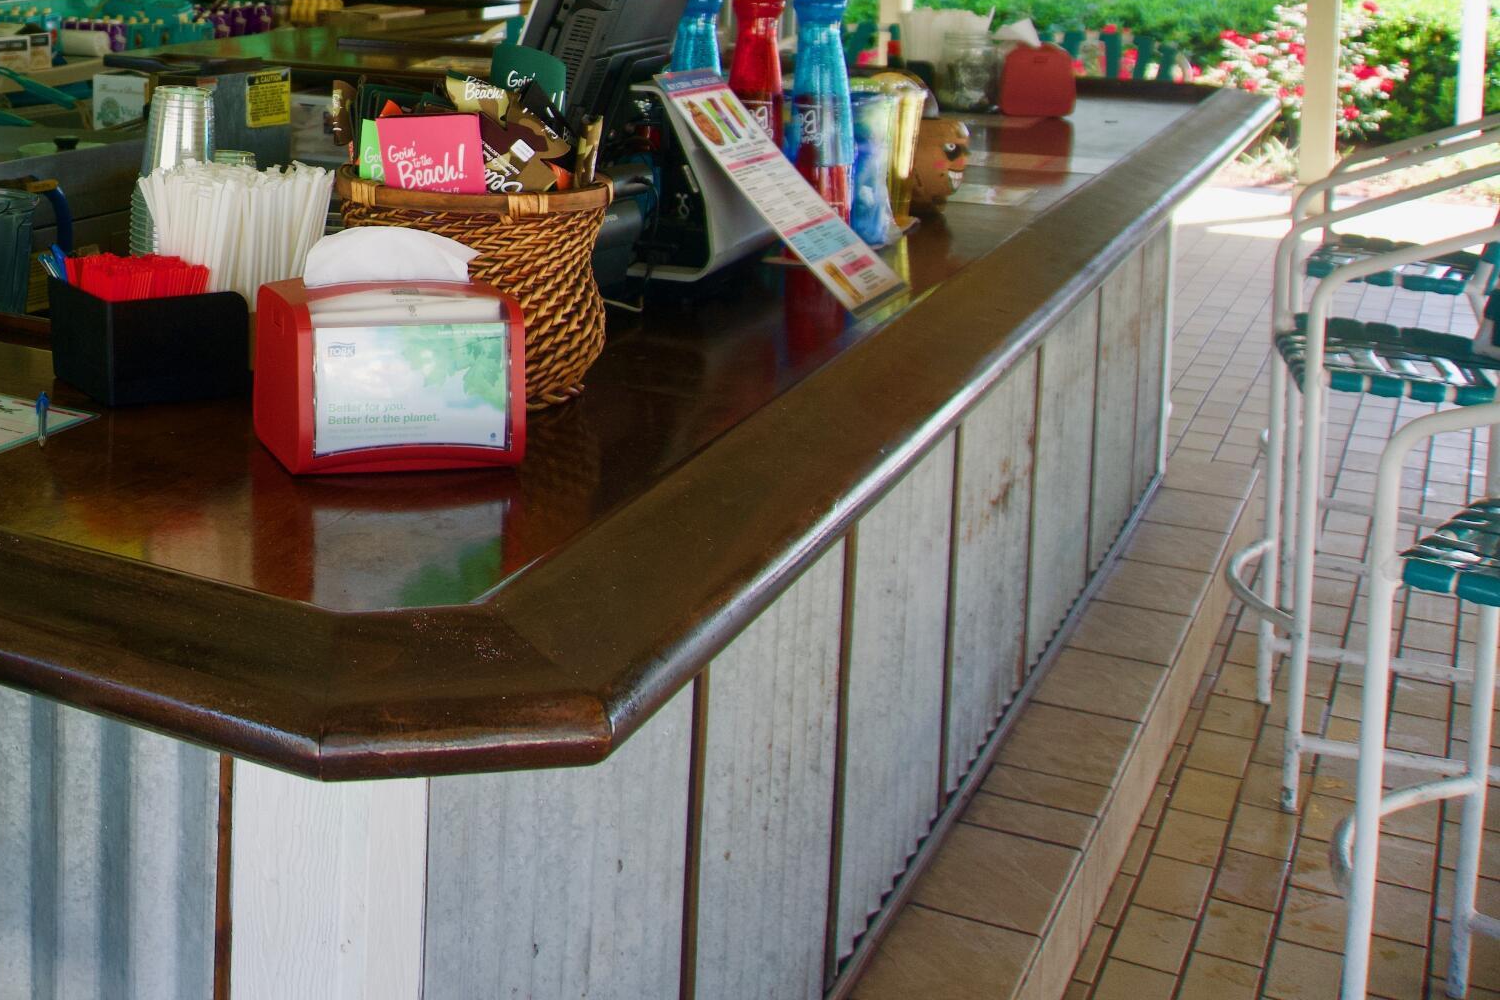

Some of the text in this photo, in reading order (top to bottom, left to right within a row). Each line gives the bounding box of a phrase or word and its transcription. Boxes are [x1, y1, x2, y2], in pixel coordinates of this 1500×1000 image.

[260, 74, 282, 83] CAUTION
[464, 82, 506, 101] Beach!
[364, 145, 381, 163] Goi
[387, 140, 416, 163] Goin'
[397, 143, 465, 190] Beach!
[328, 402, 406, 413] Better for you.
[327, 412, 440, 425] Better for the planet.
